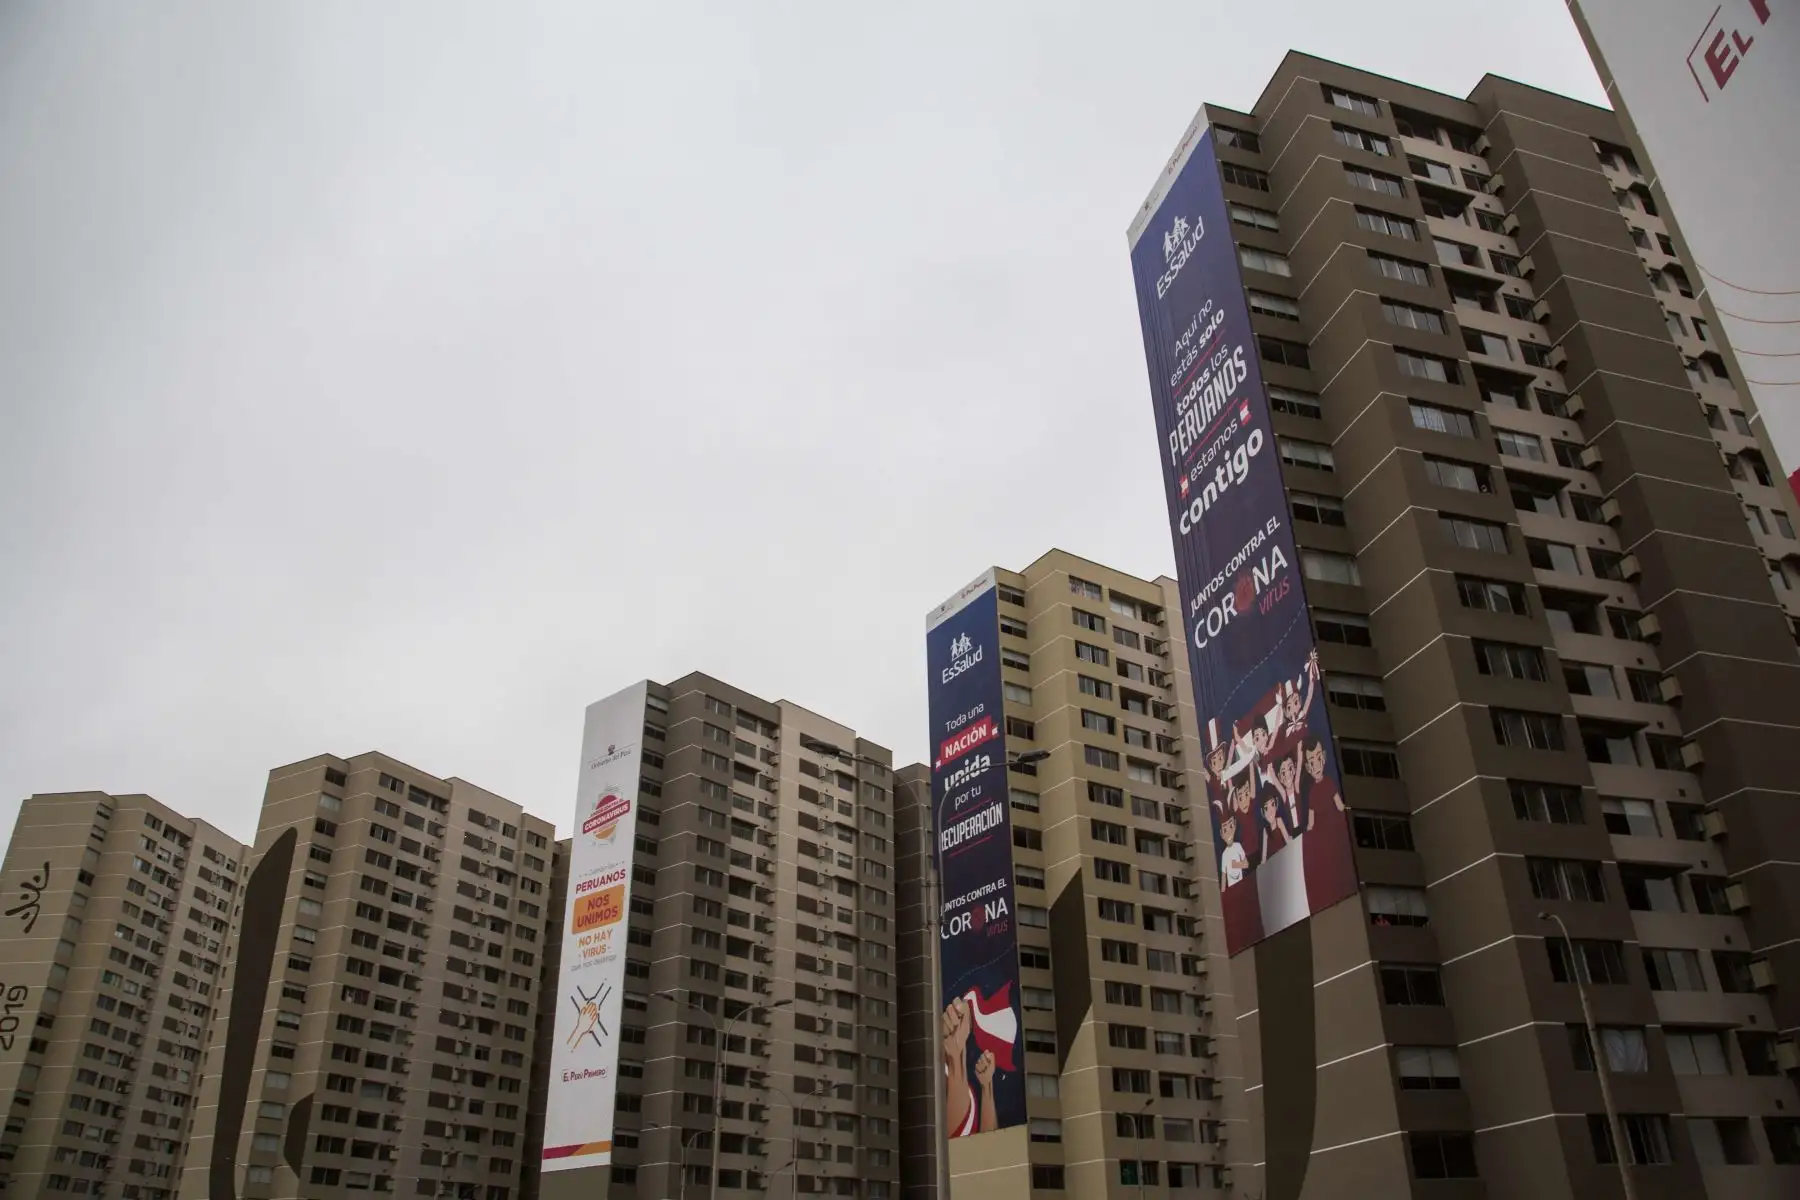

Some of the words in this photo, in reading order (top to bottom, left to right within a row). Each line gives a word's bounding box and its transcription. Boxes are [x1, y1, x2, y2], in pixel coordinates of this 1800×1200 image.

[1156, 216, 1204, 300] EsSalud
[1170, 344, 1198, 387] estás
[1199, 308, 1225, 349] solo
[1174, 316, 1198, 358] Aquí
[1199, 299, 1213, 325] no
[1176, 366, 1211, 417] todos
[1211, 343, 1229, 373] los
[1169, 345, 1247, 467] PERUANOS
[1190, 418, 1238, 482] estamos
[1180, 428, 1263, 535] contigo
[1190, 572, 1225, 618] JUNTOS
[1224, 530, 1266, 578] CONTRA
[1267, 515, 1281, 536] EL
[1258, 576, 1290, 616] virus
[942, 645, 983, 684] EsSalud
[945, 713, 967, 733] Toda
[968, 703, 984, 720] una
[944, 723, 987, 759] NACIÓN
[944, 754, 991, 793] unida
[584, 803, 629, 831] CORONAVIRUS
[954, 791, 970, 811] por
[970, 785, 982, 798] tu
[575, 869, 626, 894] PERUANOS
[966, 882, 997, 903] CONTRA
[997, 878, 1008, 890] EL
[576, 905, 618, 928] UNIMOS
[587, 894, 610, 911] NOS
[577, 935, 592, 949] NO
[593, 928, 613, 944] HAY
